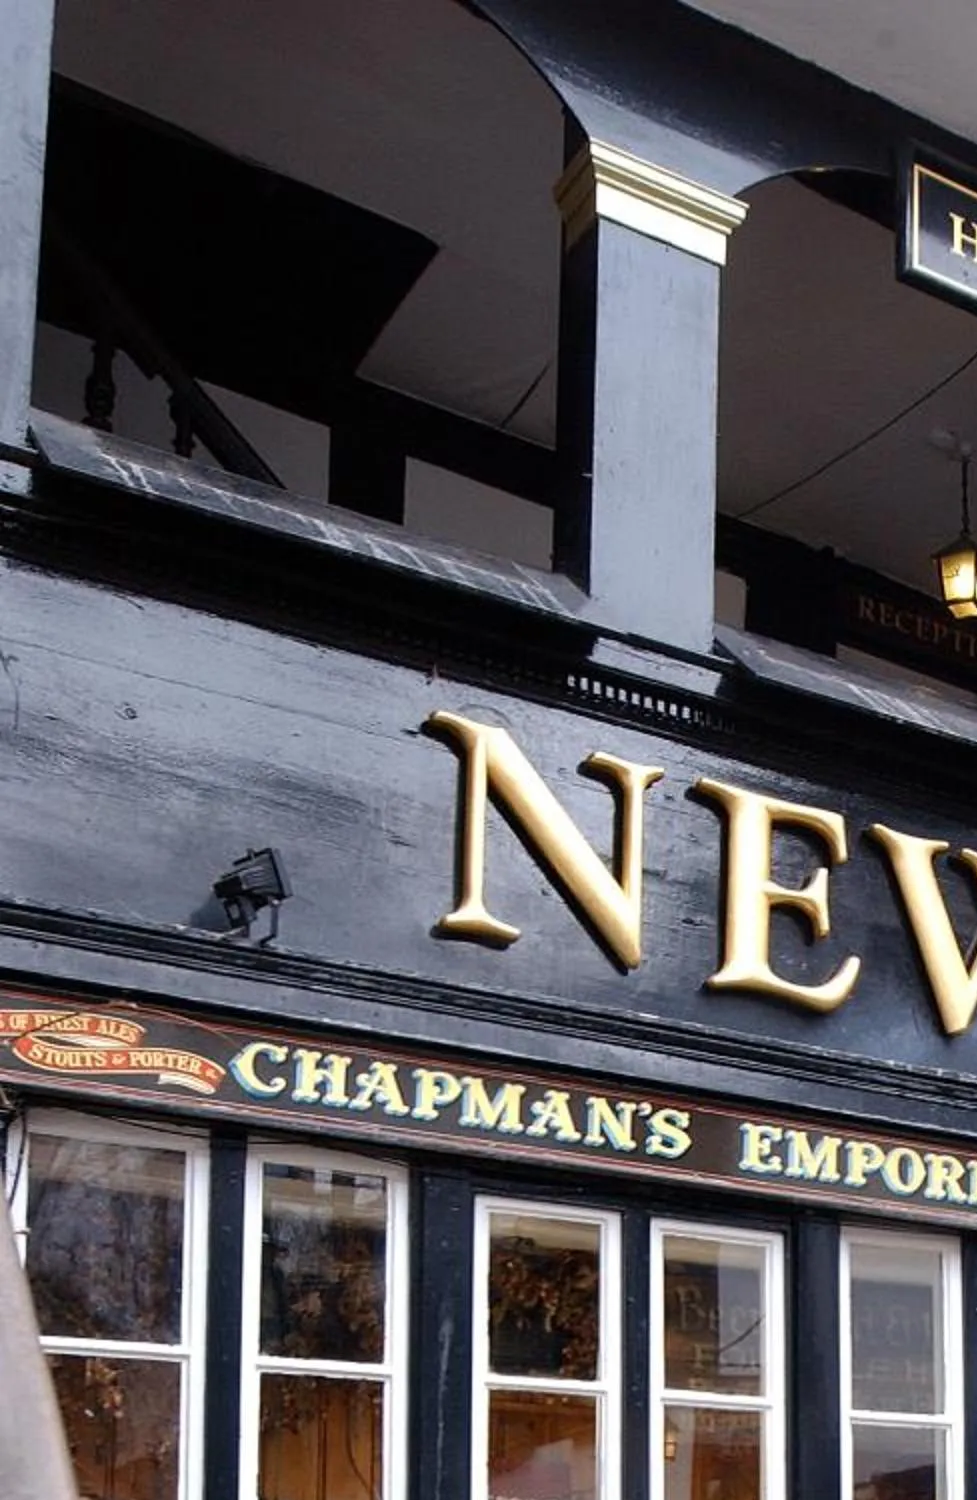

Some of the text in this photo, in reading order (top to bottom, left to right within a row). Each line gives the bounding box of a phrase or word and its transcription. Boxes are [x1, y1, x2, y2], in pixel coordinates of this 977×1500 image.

[96, 1019, 138, 1043] ALES
[28, 1043, 107, 1068] STOUTS
[128, 1051, 202, 1075] PORTER
[227, 1042, 692, 1159] CHAPMAN'S
